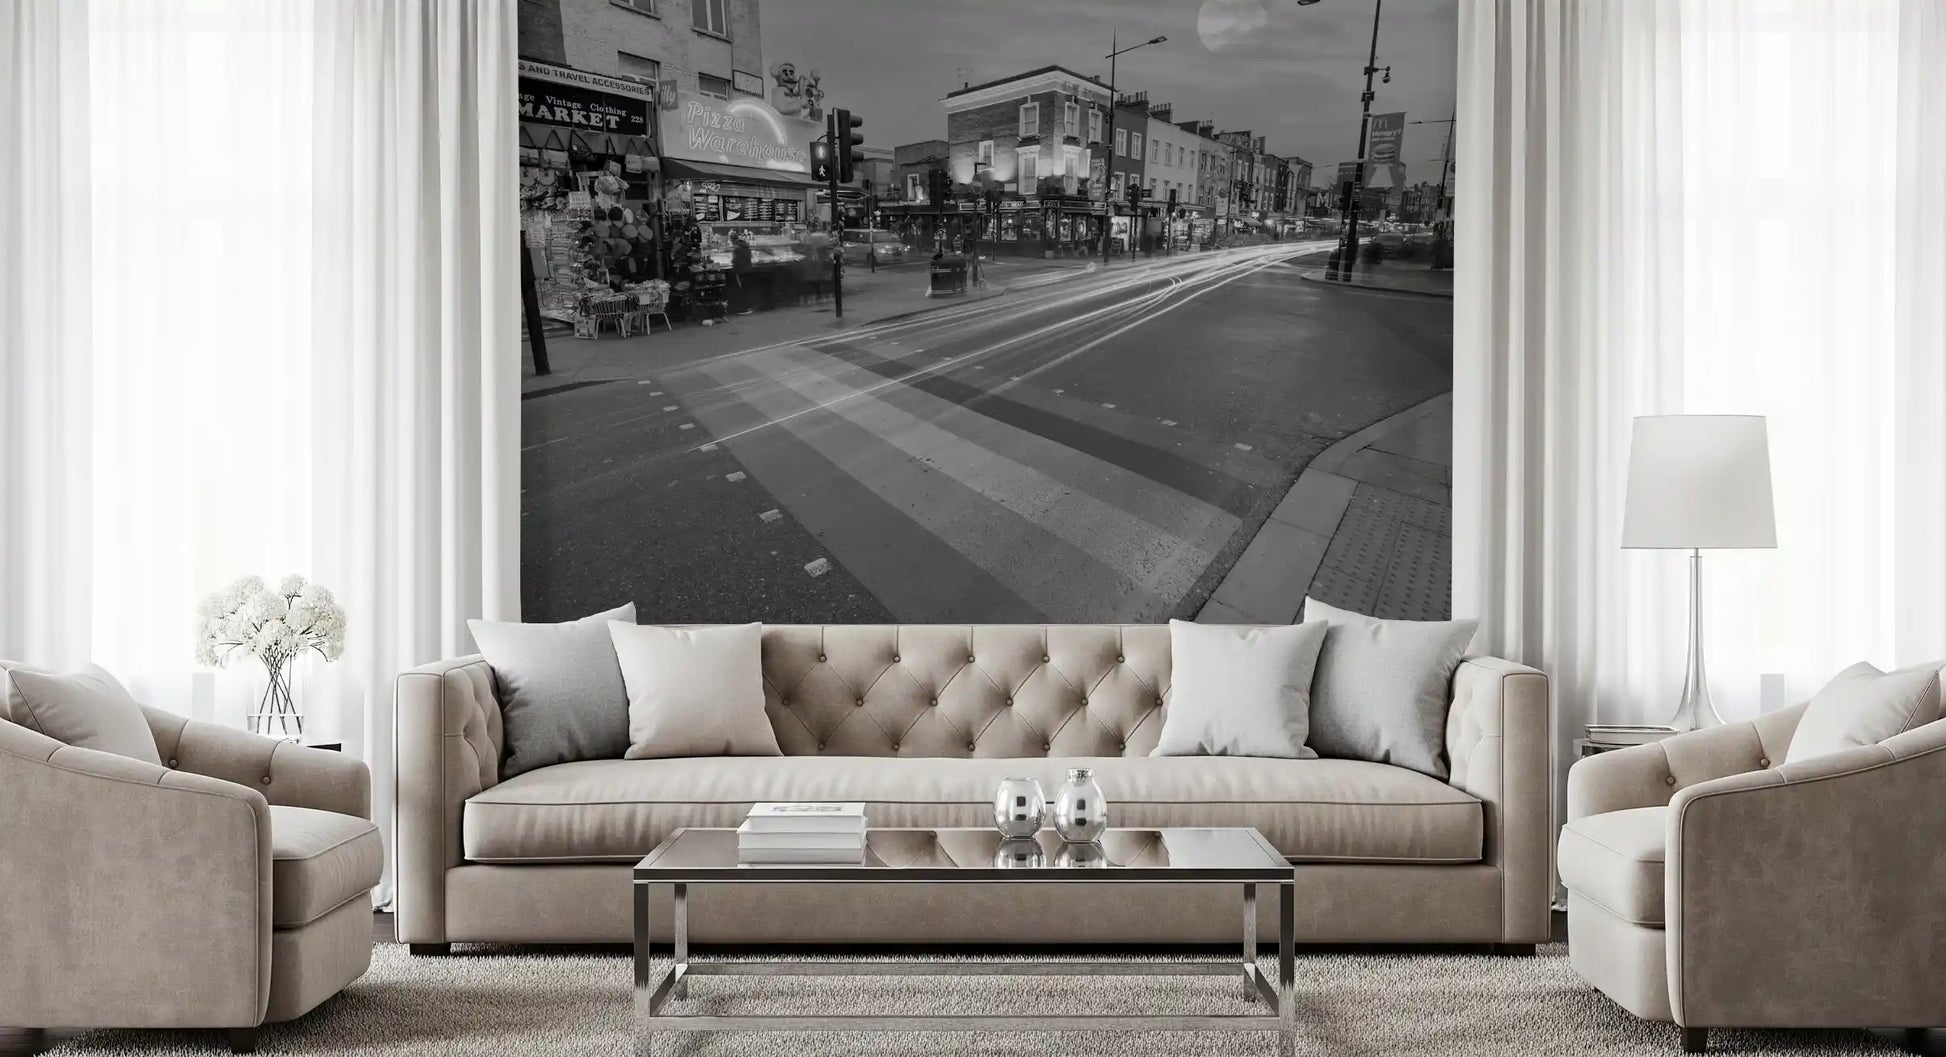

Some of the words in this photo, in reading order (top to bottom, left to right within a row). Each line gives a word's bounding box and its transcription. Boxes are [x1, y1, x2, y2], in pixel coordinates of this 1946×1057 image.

[528, 65, 550, 75] AND
[552, 70, 590, 83] TRAVEL
[592, 78, 650, 96] ACCESSORIES
[519, 103, 620, 129] MARKET
[545, 95, 582, 109] Vintage
[590, 102, 627, 117] Clothing
[686, 101, 745, 133] Pizza
[686, 125, 807, 163] Warehouse
